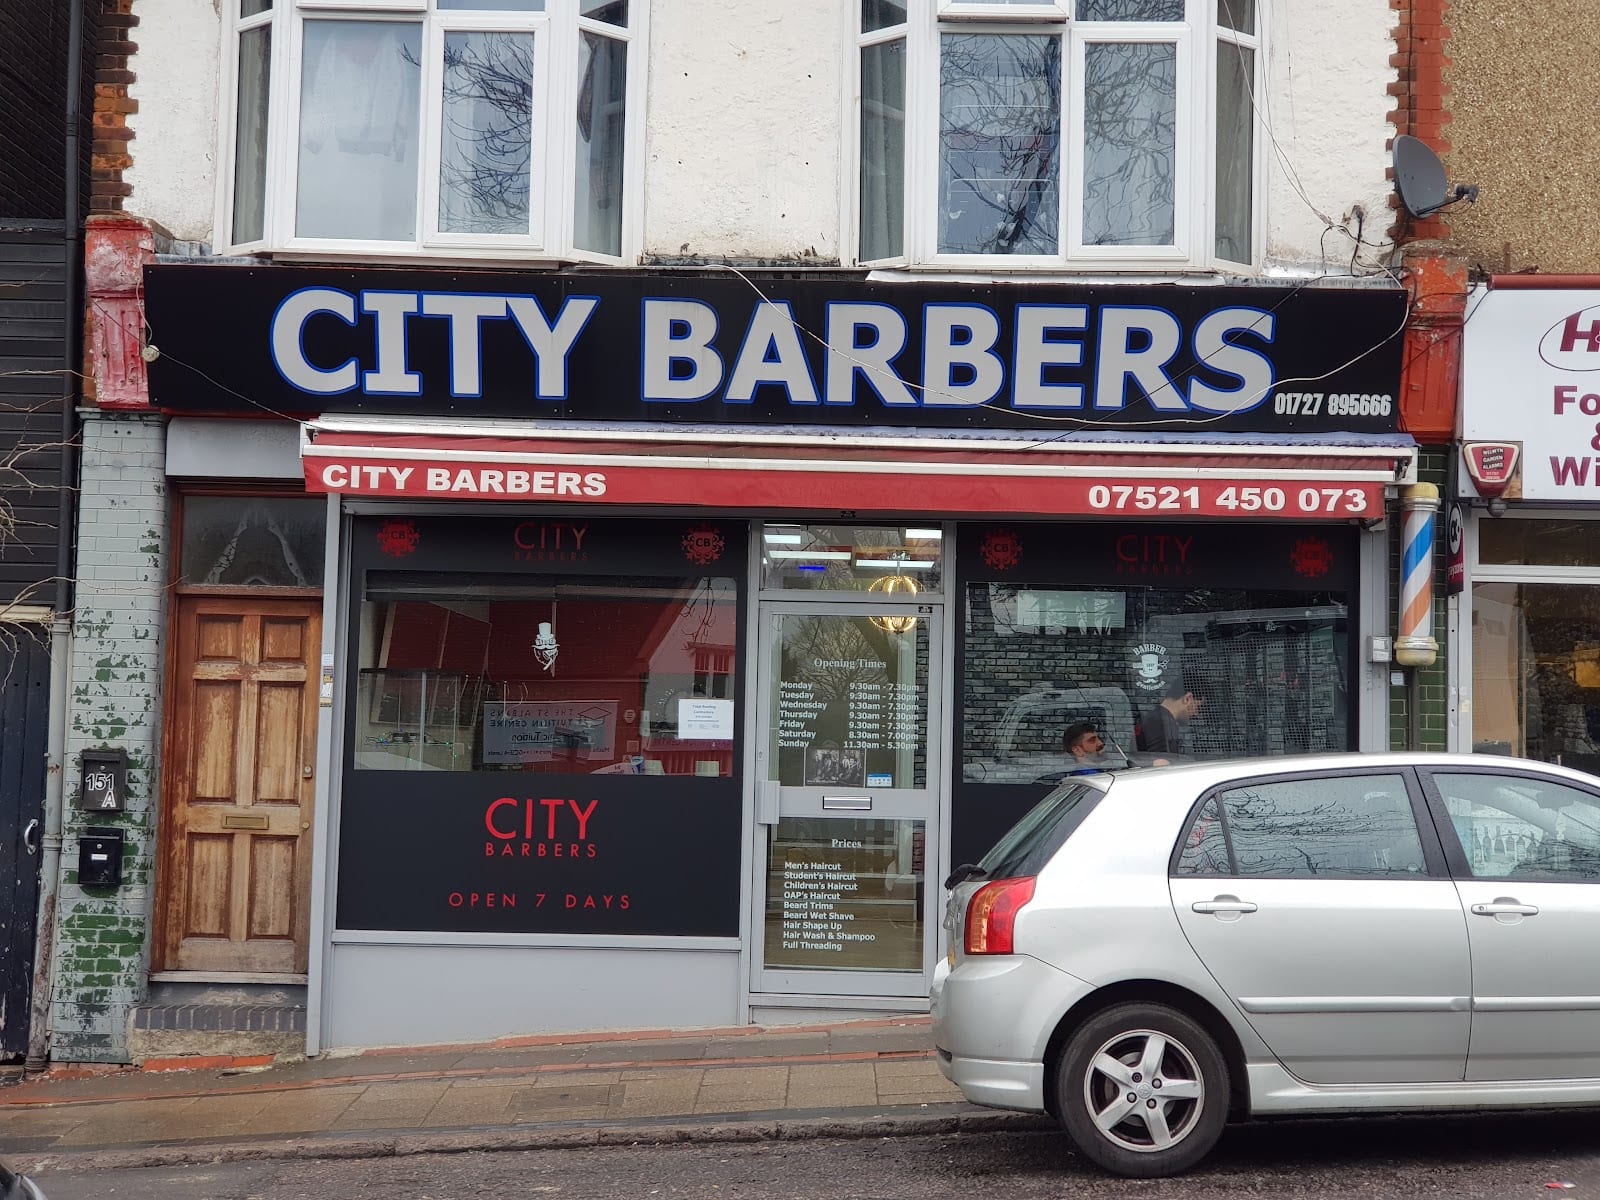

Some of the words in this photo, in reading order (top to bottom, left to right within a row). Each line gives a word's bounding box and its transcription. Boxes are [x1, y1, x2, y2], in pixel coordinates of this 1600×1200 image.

[270, 286, 600, 399] CITY
[640, 297, 1276, 414] BARBERS
[1274, 392, 1324, 415] 01727
[1328, 394, 1392, 416] 895666
[322, 464, 416, 490] CITY
[426, 466, 607, 497] BARBERS
[1088, 485, 1201, 510] 07521
[1216, 486, 1286, 511] 450
[1298, 487, 1368, 512] 073
[514, 521, 588, 550] CITY
[696, 538, 710, 547] CB
[1116, 534, 1193, 563] CITY
[1132, 643, 1167, 656] BARBER
[814, 658, 856, 670] Opening
[858, 659, 887, 668] Times
[780, 682, 812, 690] Monday
[888, 684, 919, 693] 7.30pm
[780, 691, 814, 700] Tuesday
[888, 693, 919, 702] 7.30pm
[780, 701, 827, 710] Wednesday
[888, 703, 919, 712] 7.30pm
[780, 710, 818, 720] Thursday
[888, 713, 919, 722] 7.30pm
[780, 720, 805, 729] Friday
[888, 722, 919, 732] 7.30pm
[779, 730, 816, 739] Saturday
[888, 732, 919, 741] 7.00pm
[779, 740, 809, 749] Sunday
[888, 742, 919, 751] 5.30pm
[86, 774, 114, 791] 151
[101, 790, 116, 808] A
[485, 798, 598, 840] CITY
[832, 838, 862, 848] Prices
[485, 842, 596, 858] BARBERS
[784, 881, 825, 890] Children's
[449, 892, 516, 908] OPEN
[536, 894, 546, 908] 7
[566, 894, 630, 910] DAYS
[810, 892, 840, 900] Haircut
[829, 912, 854, 920] Shave
[803, 922, 828, 931] Shape
[830, 922, 842, 931] Up
[837, 932, 875, 942] Shampoo
[800, 942, 842, 951] Threading
